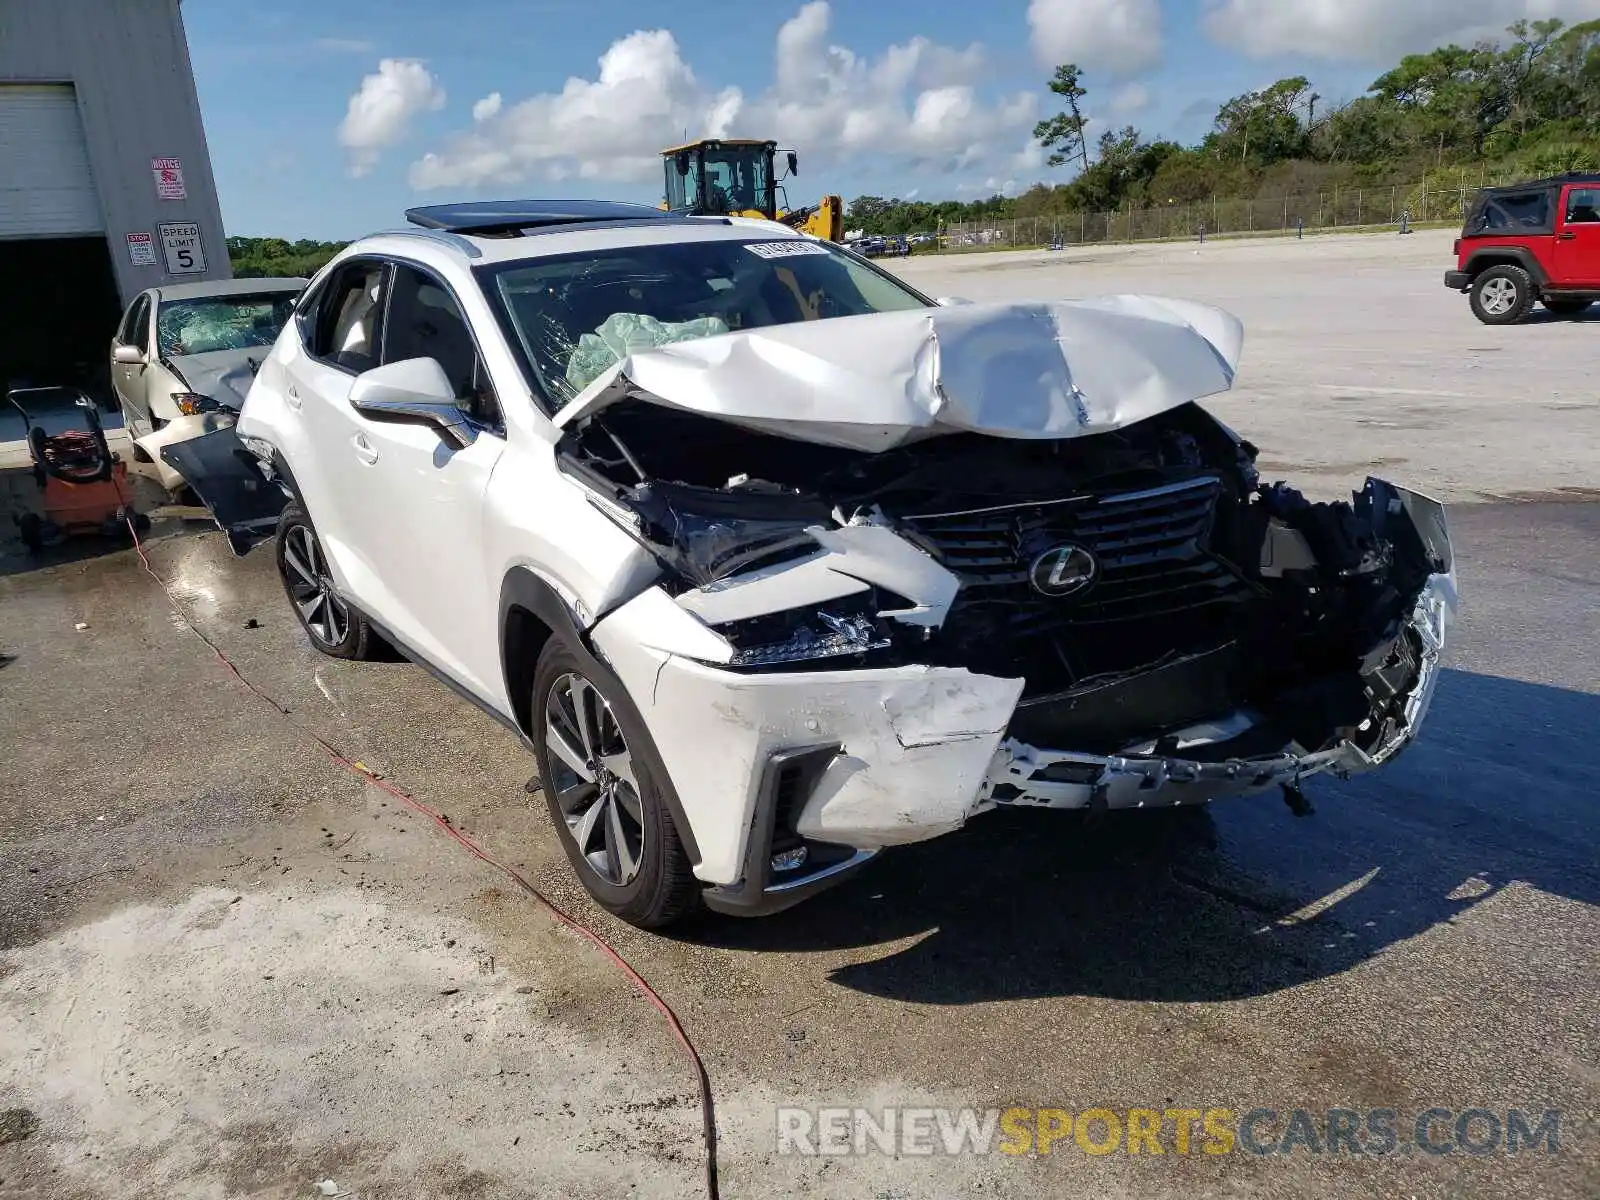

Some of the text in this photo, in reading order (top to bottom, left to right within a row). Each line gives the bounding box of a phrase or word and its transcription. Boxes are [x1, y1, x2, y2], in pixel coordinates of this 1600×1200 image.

[163, 228, 197, 236] SPEED
[168, 239, 195, 247] LIMIT
[177, 250, 194, 268] 5
